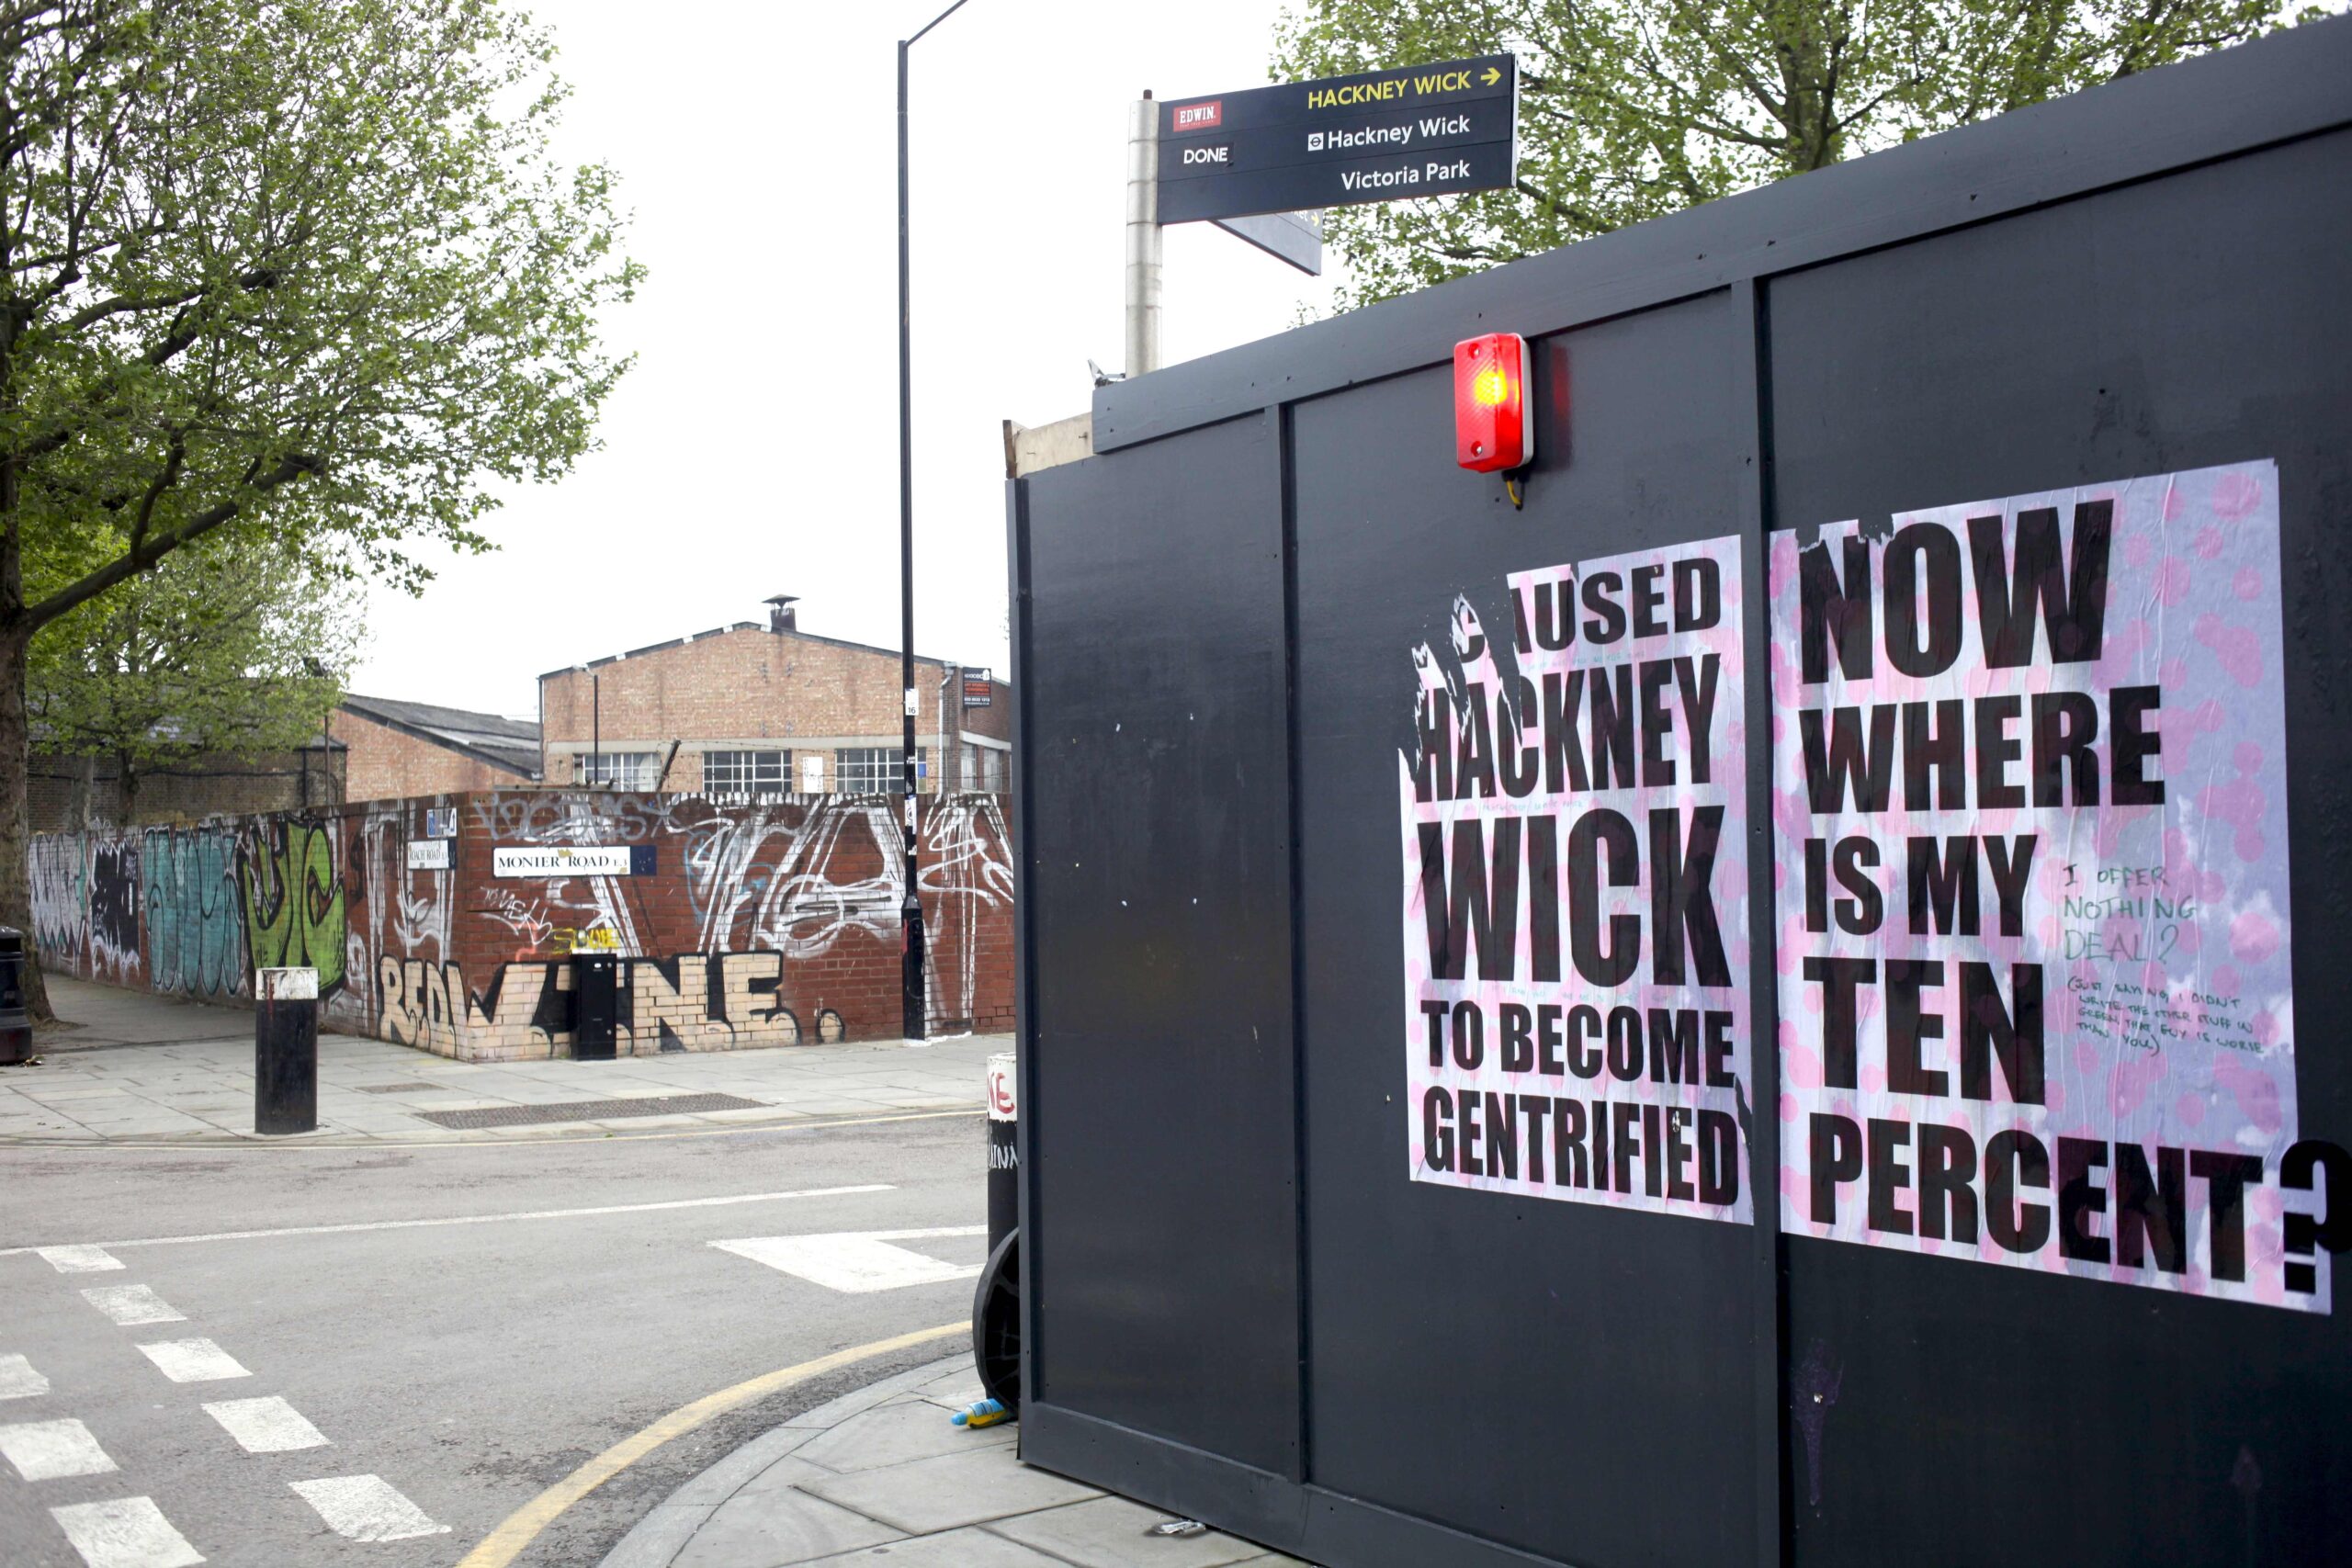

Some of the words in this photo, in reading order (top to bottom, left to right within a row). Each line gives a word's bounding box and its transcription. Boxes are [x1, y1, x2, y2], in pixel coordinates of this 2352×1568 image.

[1308, 78, 1408, 109] HACKNEY
[1414, 70, 1472, 96] WICK
[1328, 124, 1413, 149] Hackney
[1419, 115, 1471, 138] Wick
[1183, 147, 1228, 164] DONE
[1341, 164, 1419, 190] Victoria
[1426, 159, 1471, 181] Park
[1800, 499, 2114, 684] NOW
[1416, 653, 1721, 804] HACKNEY
[1798, 685, 2166, 815] WHERE
[498, 855, 560, 868] MONIER
[569, 855, 609, 868] ROAD
[1417, 805, 1734, 987] WICK
[1804, 836, 1883, 935] IS
[1907, 834, 2038, 938] MY
[2064, 863, 2078, 886] I
[2097, 866, 2168, 886] OFFER
[2064, 896, 2198, 919] NOTHING
[1420, 999, 1485, 1071] TO
[1500, 1002, 1736, 1088] BECOME
[1803, 956, 2045, 1106] TEN
[2127, 1004, 2150, 1016] THE
[1423, 1086, 1738, 1206] GENTRIFIED
[1809, 1112, 2352, 1297] PERCENT?
